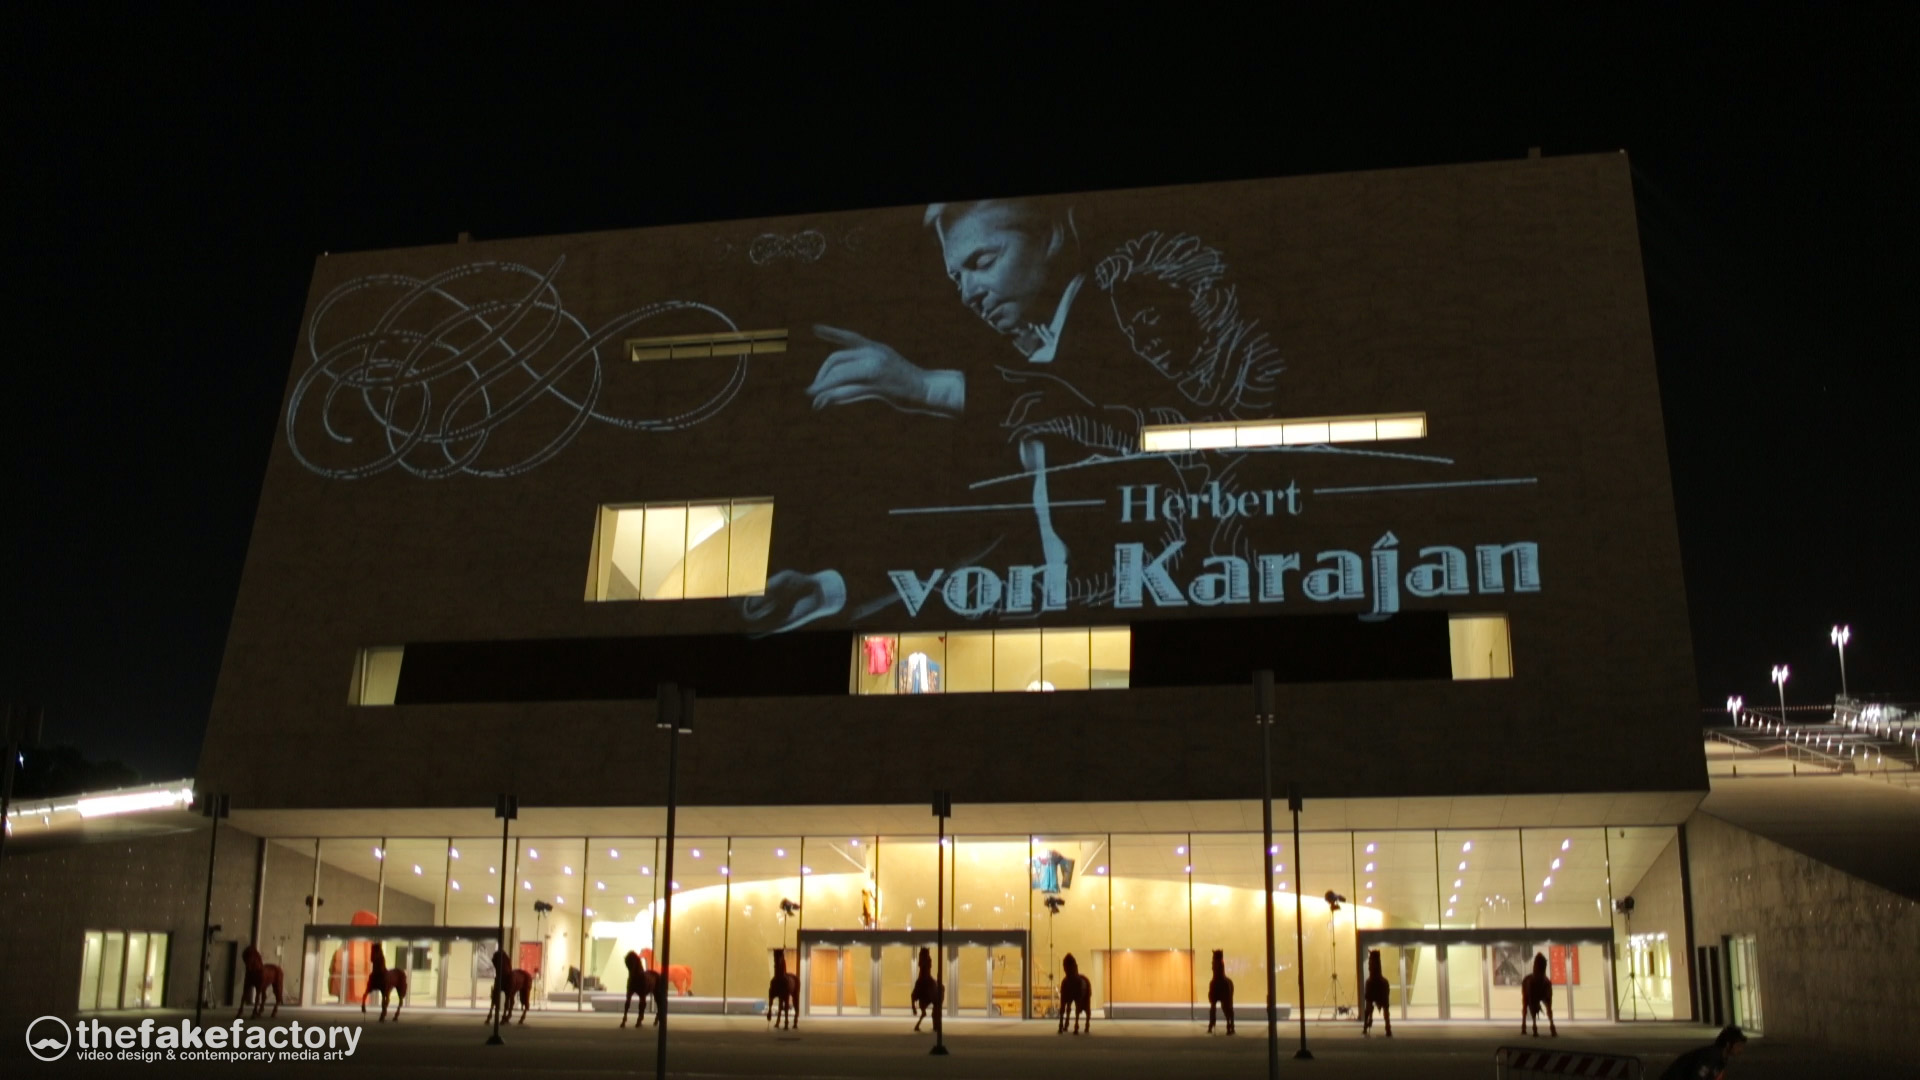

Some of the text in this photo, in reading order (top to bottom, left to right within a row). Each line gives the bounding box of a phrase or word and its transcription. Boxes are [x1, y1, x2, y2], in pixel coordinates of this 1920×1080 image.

[1121, 480, 1302, 523] Herbert
[888, 530, 1541, 622] von Karajan
